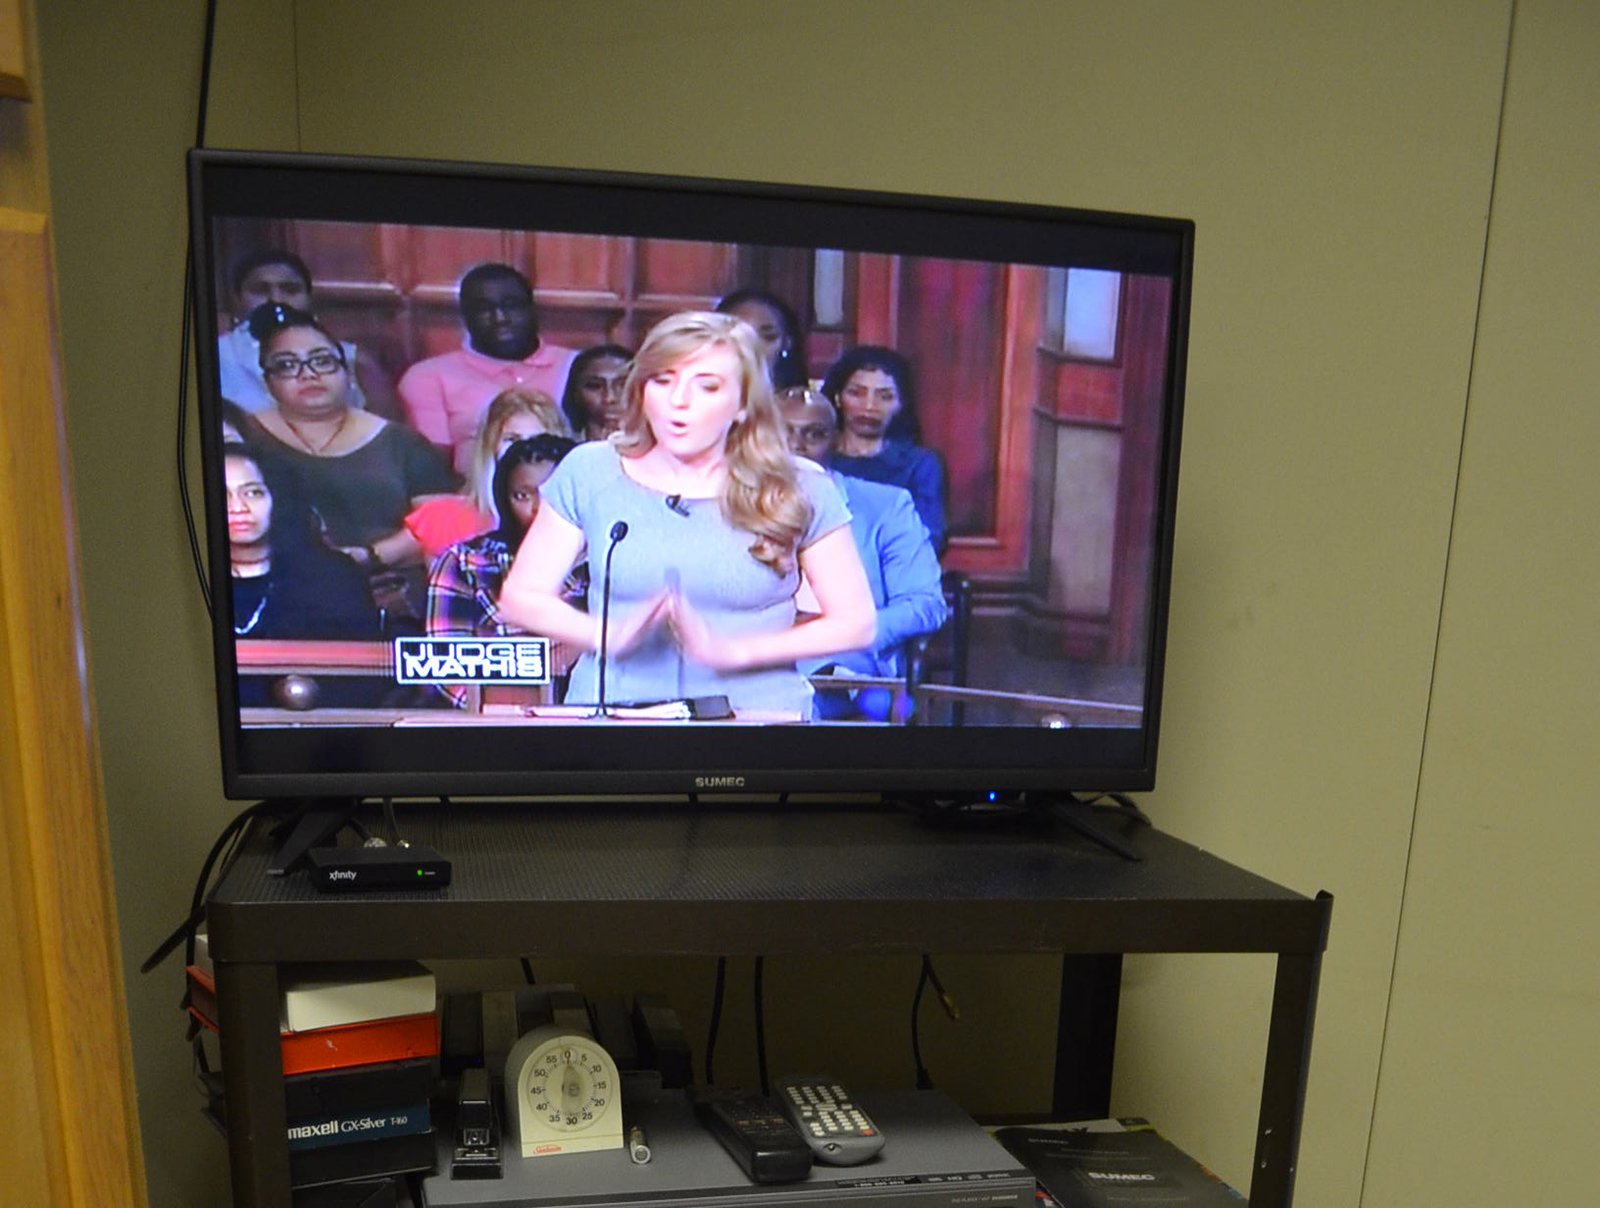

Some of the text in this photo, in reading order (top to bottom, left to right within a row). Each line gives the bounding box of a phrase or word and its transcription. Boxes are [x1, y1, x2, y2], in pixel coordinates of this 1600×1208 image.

[403, 643, 542, 661] JUDGE
[405, 658, 543, 678] MATHIS
[695, 776, 745, 788] SUMEC
[329, 870, 357, 881] xfinity
[546, 1055, 558, 1063] 55
[534, 1069, 546, 1077] 50
[594, 1098, 605, 1106] 20
[536, 1103, 548, 1111] 40
[549, 1114, 561, 1122] 35
[582, 1112, 593, 1120] 25
[566, 1117, 578, 1125] 30
[288, 1120, 339, 1140] maxell
[341, 1116, 386, 1133] GX-Silver
